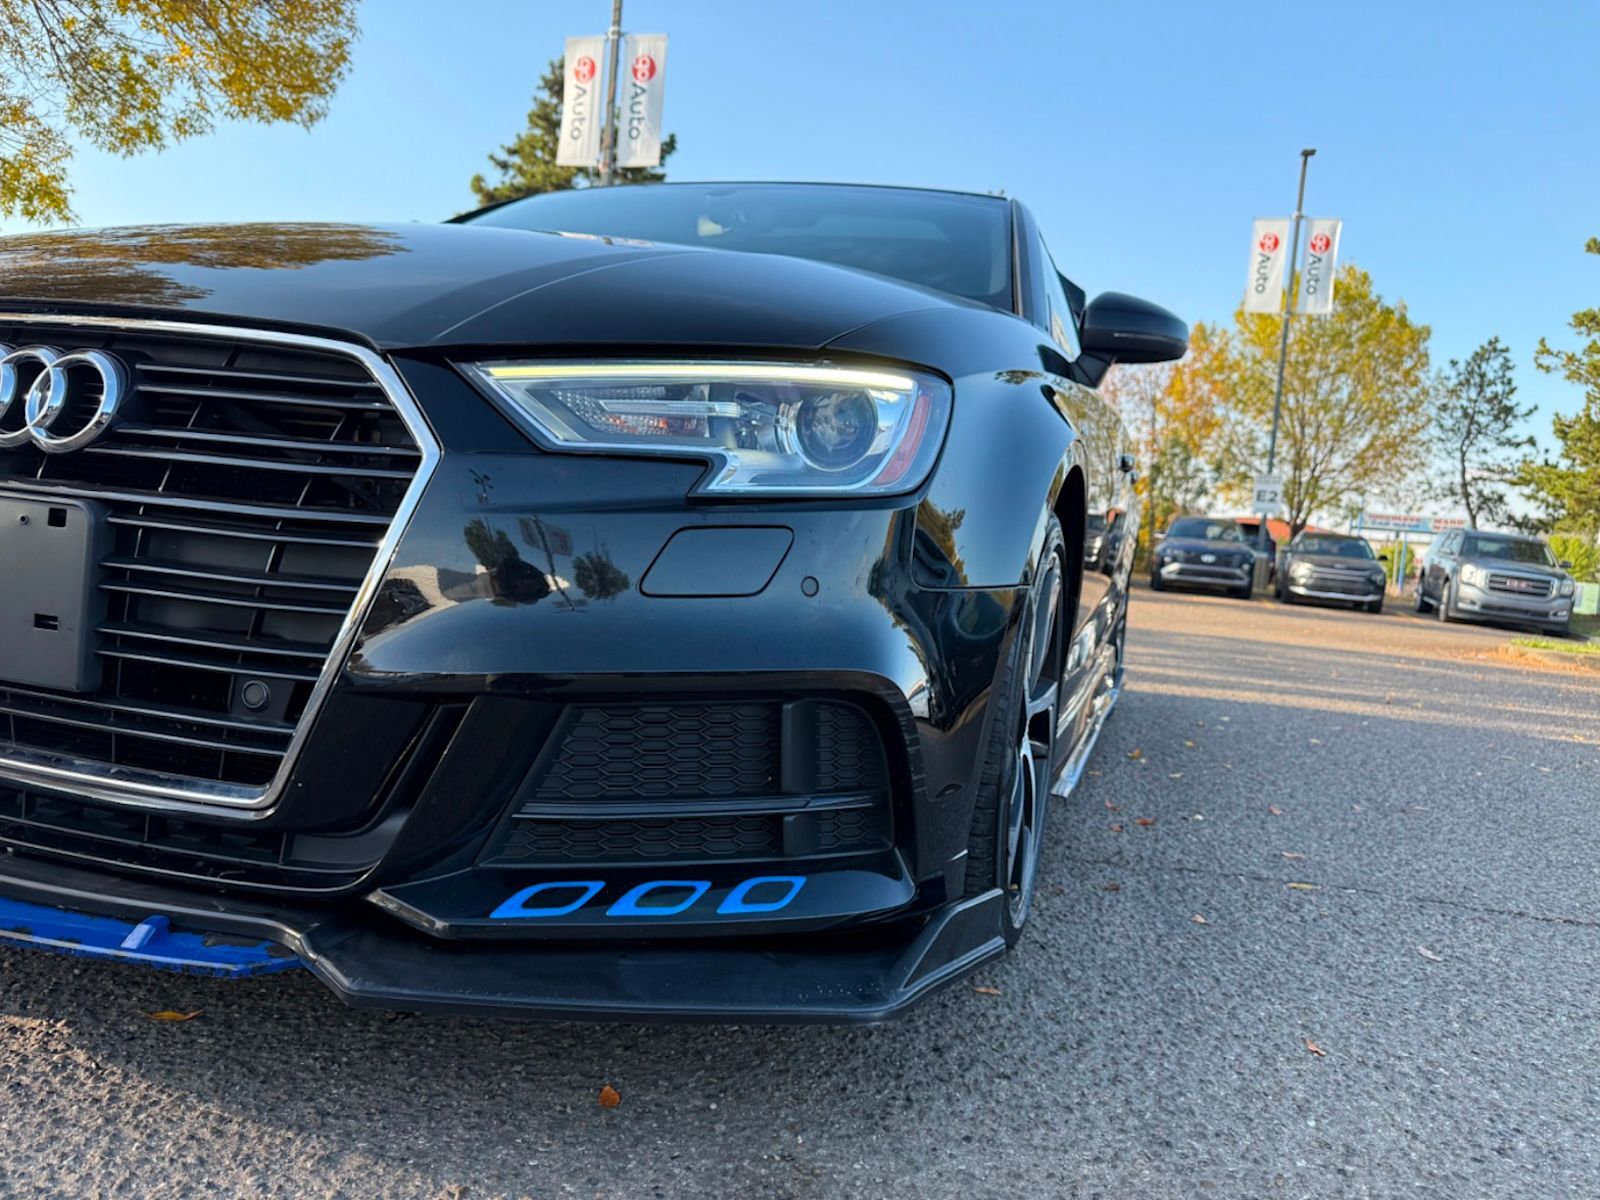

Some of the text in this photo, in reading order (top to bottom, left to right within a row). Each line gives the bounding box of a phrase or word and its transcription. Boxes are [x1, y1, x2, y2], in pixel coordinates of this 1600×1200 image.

[571, 85, 587, 140] Auto
[629, 82, 647, 140] Auto
[1255, 253, 1271, 294] Auto
[1306, 254, 1322, 295] Auto
[1256, 489, 1278, 502] E2
